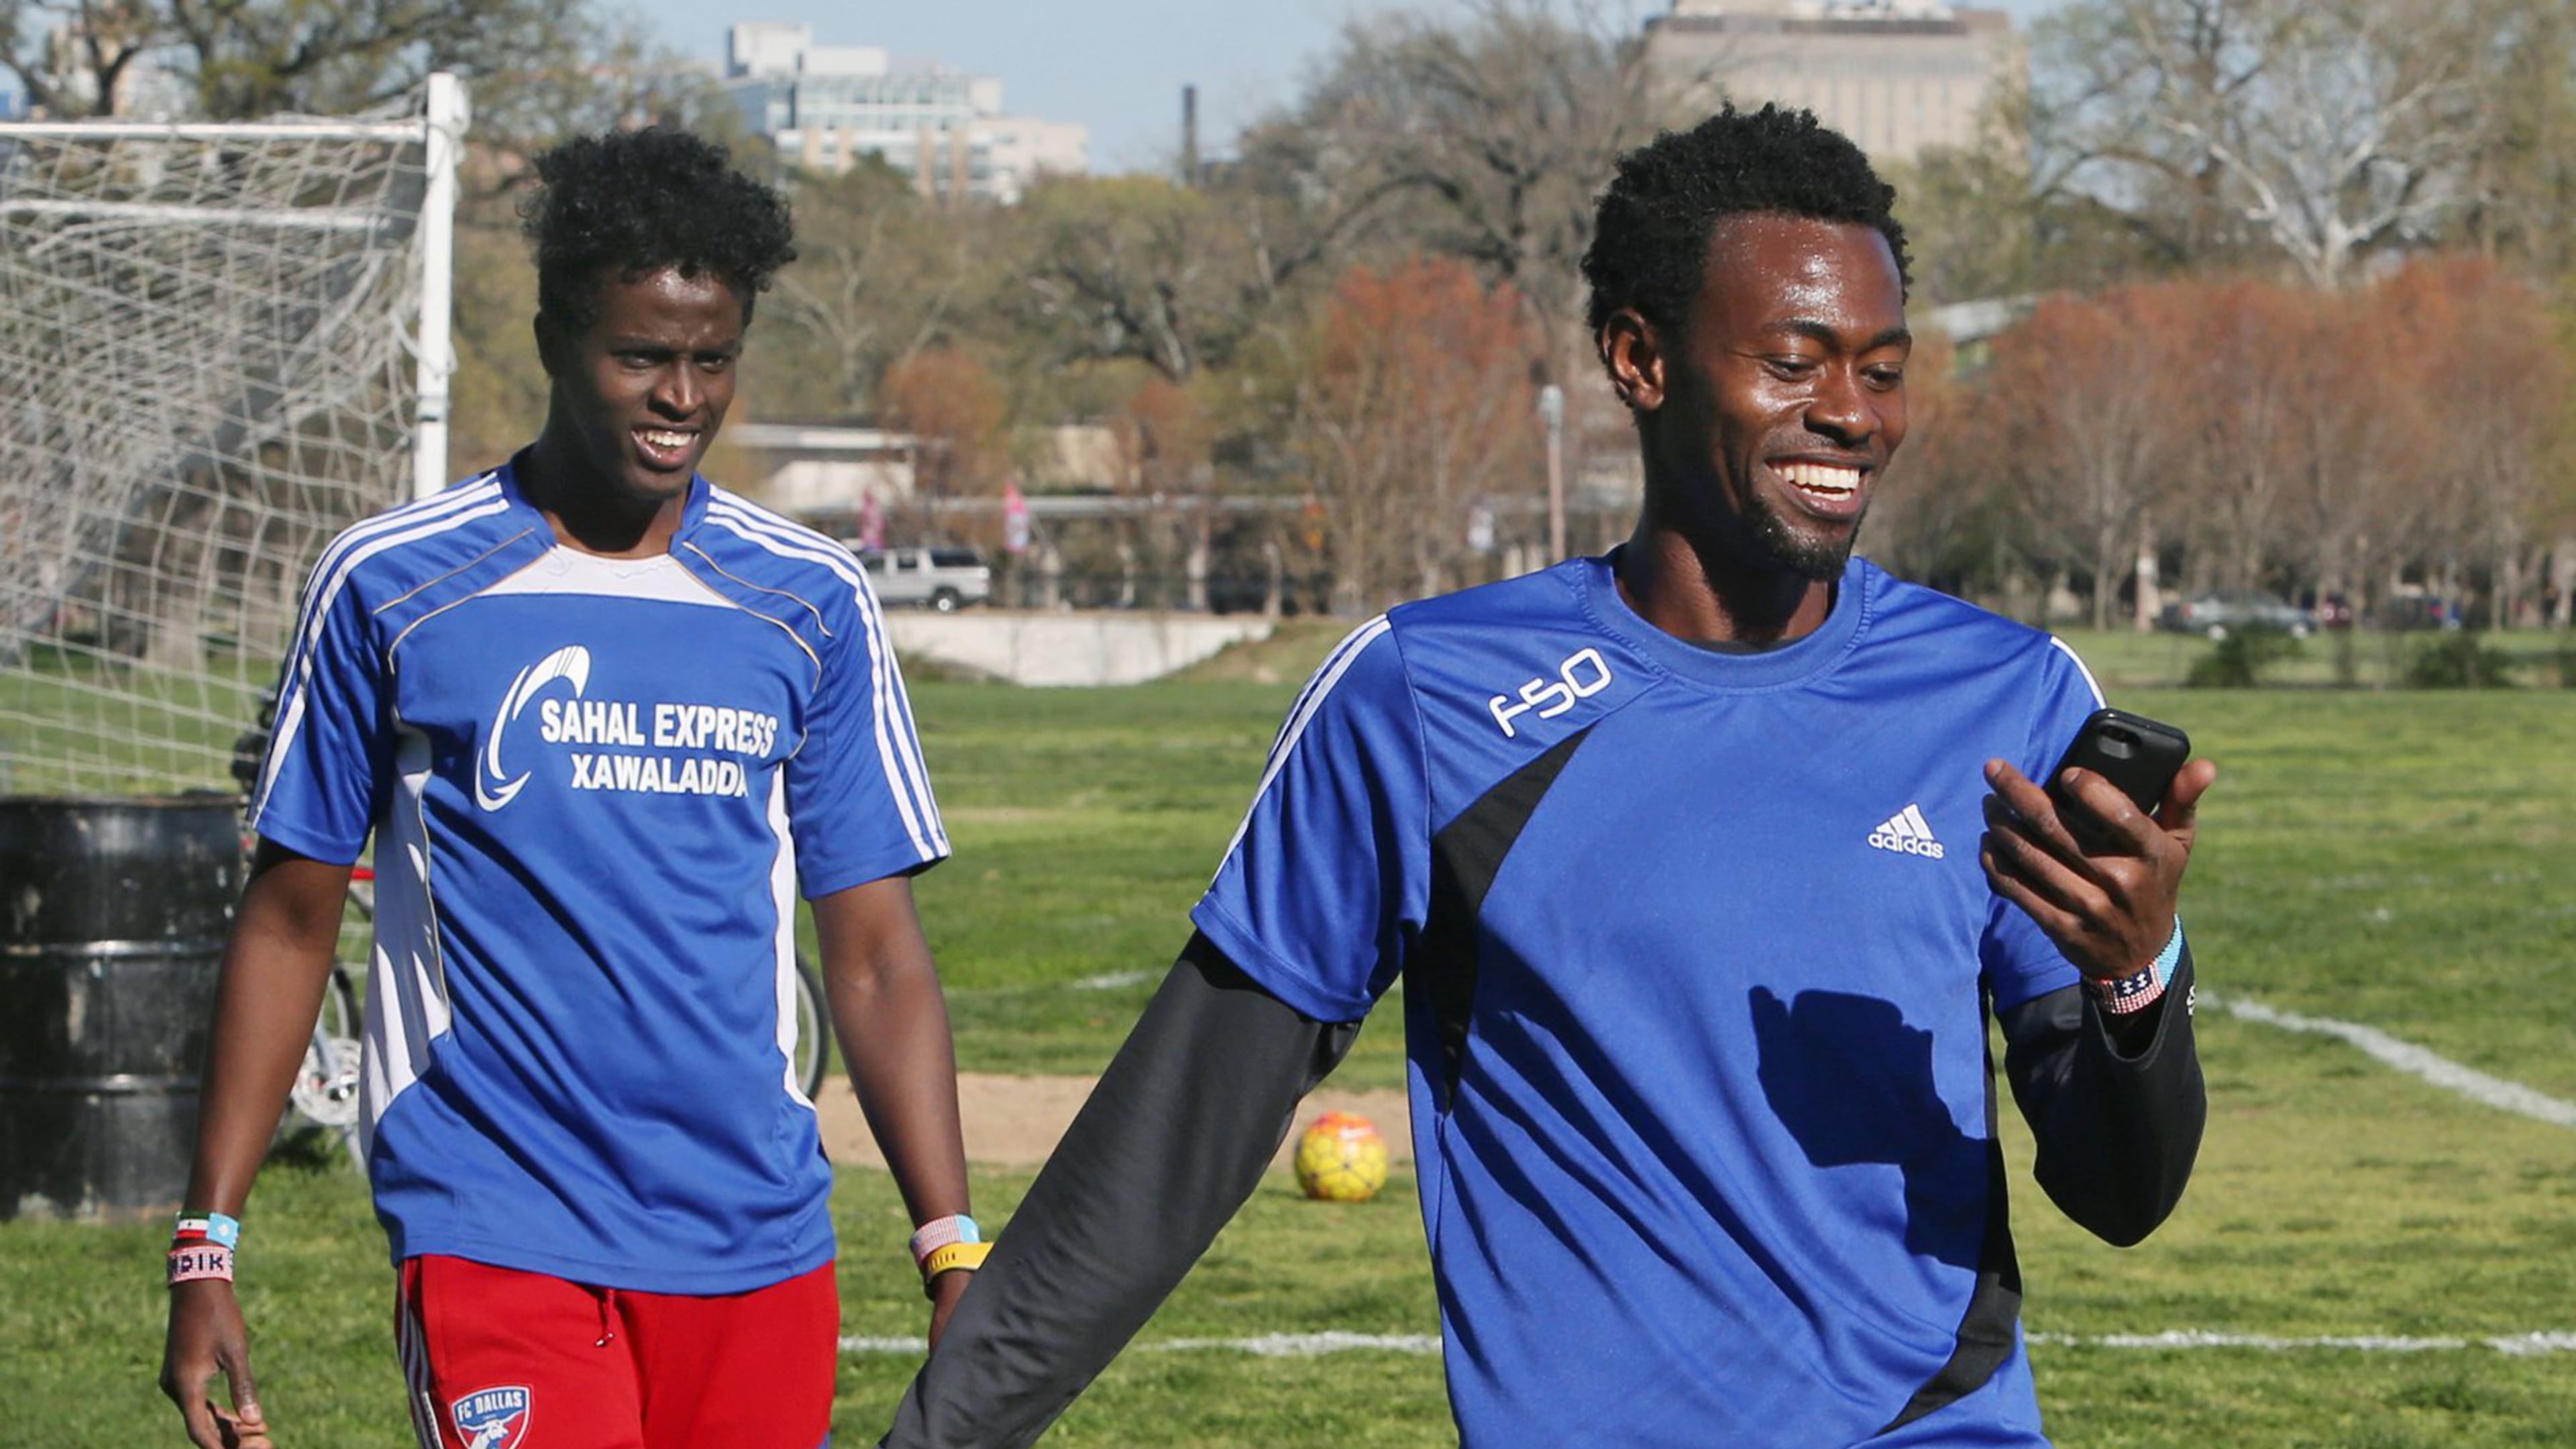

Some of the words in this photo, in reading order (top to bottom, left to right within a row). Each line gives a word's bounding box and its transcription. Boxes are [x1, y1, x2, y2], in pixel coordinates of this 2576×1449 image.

[541, 698, 646, 747] SAHAL
[653, 703, 778, 759] EXPRESS
[1868, 833, 1944, 859] adidas
[457, 1401, 472, 1422] FC
[475, 1392, 523, 1414] DALLAS
